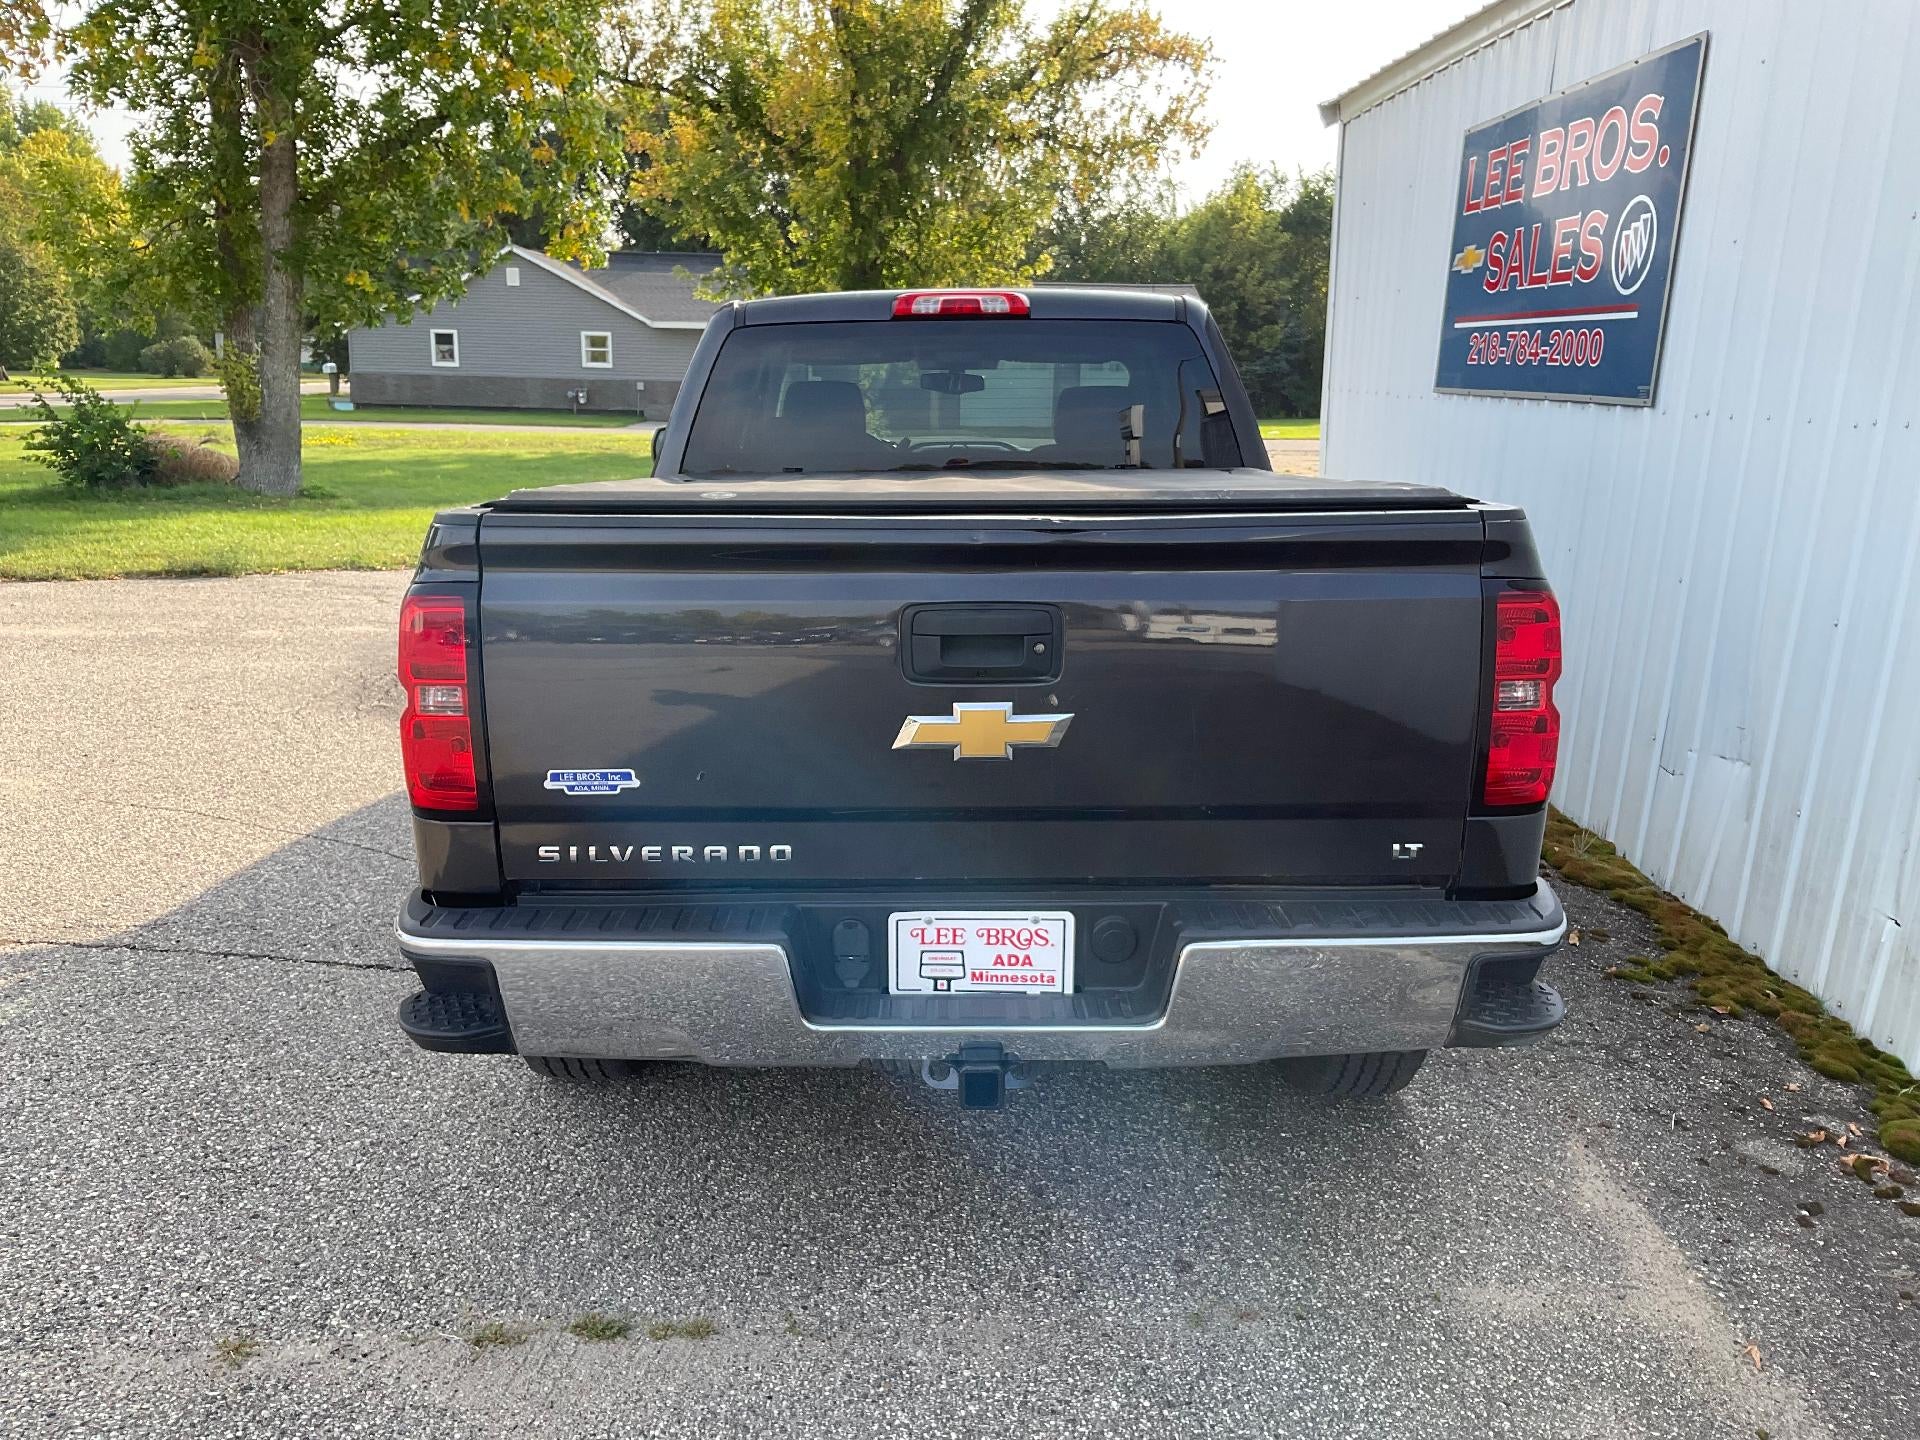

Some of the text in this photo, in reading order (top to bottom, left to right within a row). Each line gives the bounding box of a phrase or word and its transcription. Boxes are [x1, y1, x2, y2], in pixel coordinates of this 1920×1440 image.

[1463, 94, 1670, 215] LEE BROS.
[1483, 210, 1608, 293] SALES
[1467, 328, 1604, 367] 218-784-2000
[559, 773, 574, 781] LEE
[608, 772, 623, 781] Inc.
[538, 844, 792, 863] SILVERADO
[1392, 843, 1423, 860] LT
[910, 927, 1055, 950] LEE BROS.
[992, 953, 1033, 967] ADA
[970, 970, 1056, 984] Minnesota
